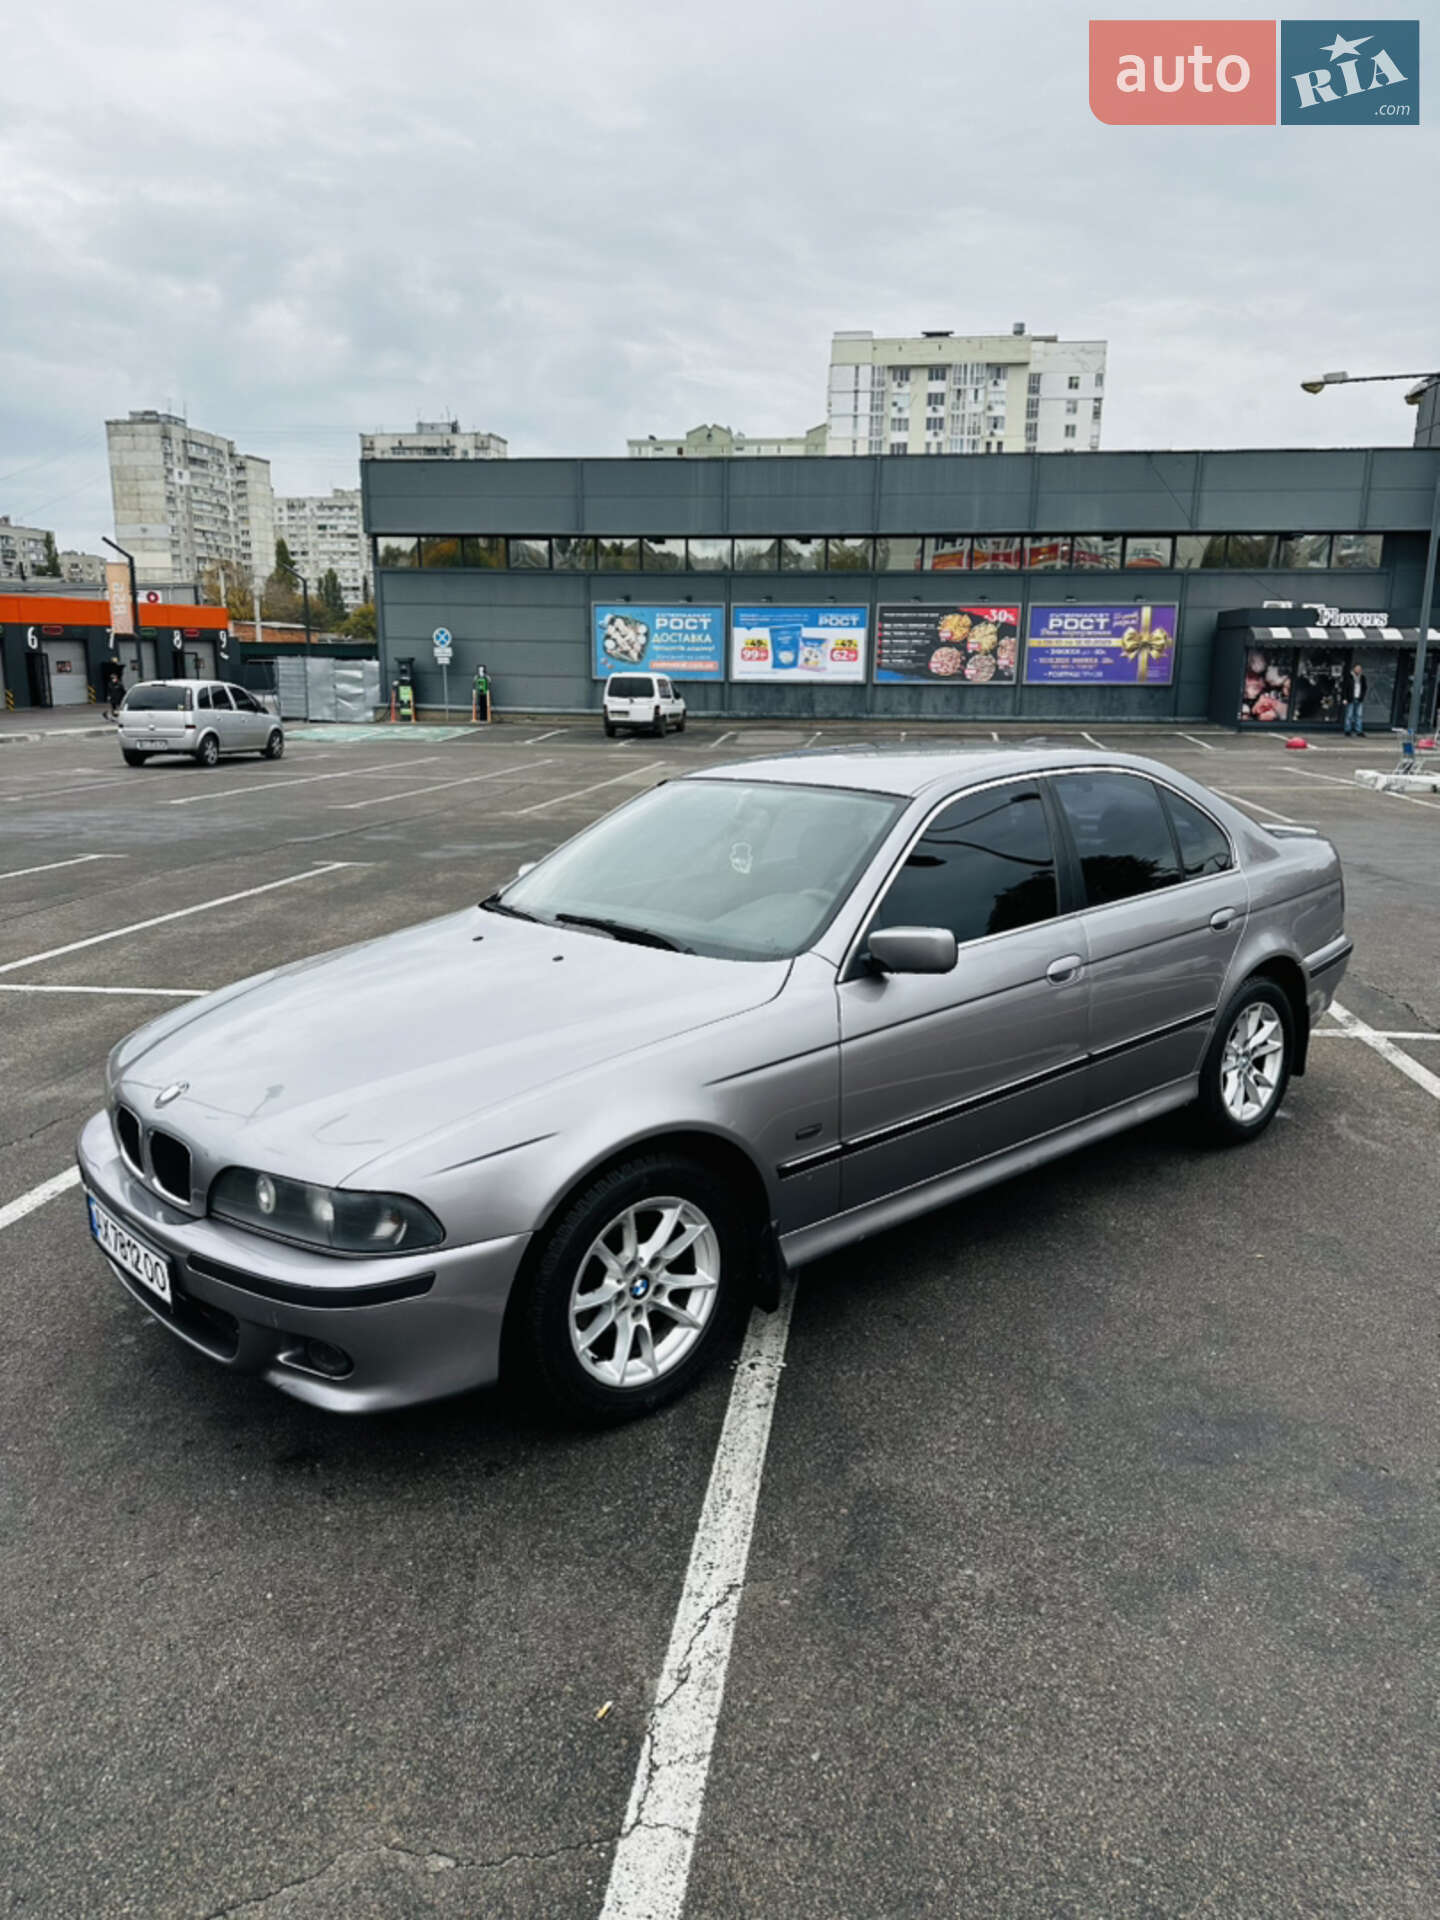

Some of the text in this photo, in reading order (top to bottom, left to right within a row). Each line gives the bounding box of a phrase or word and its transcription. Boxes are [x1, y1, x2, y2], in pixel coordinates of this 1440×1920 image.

[656, 618, 712, 630] РОСТ
[1049, 618, 1110, 630] РОСТ
[1316, 607, 1389, 627] Flowers
[27, 626, 39, 649] 6
[173, 630, 182, 649] 8
[219, 630, 227, 648] 9
[652, 633, 712, 644] ДОСТАВКА
